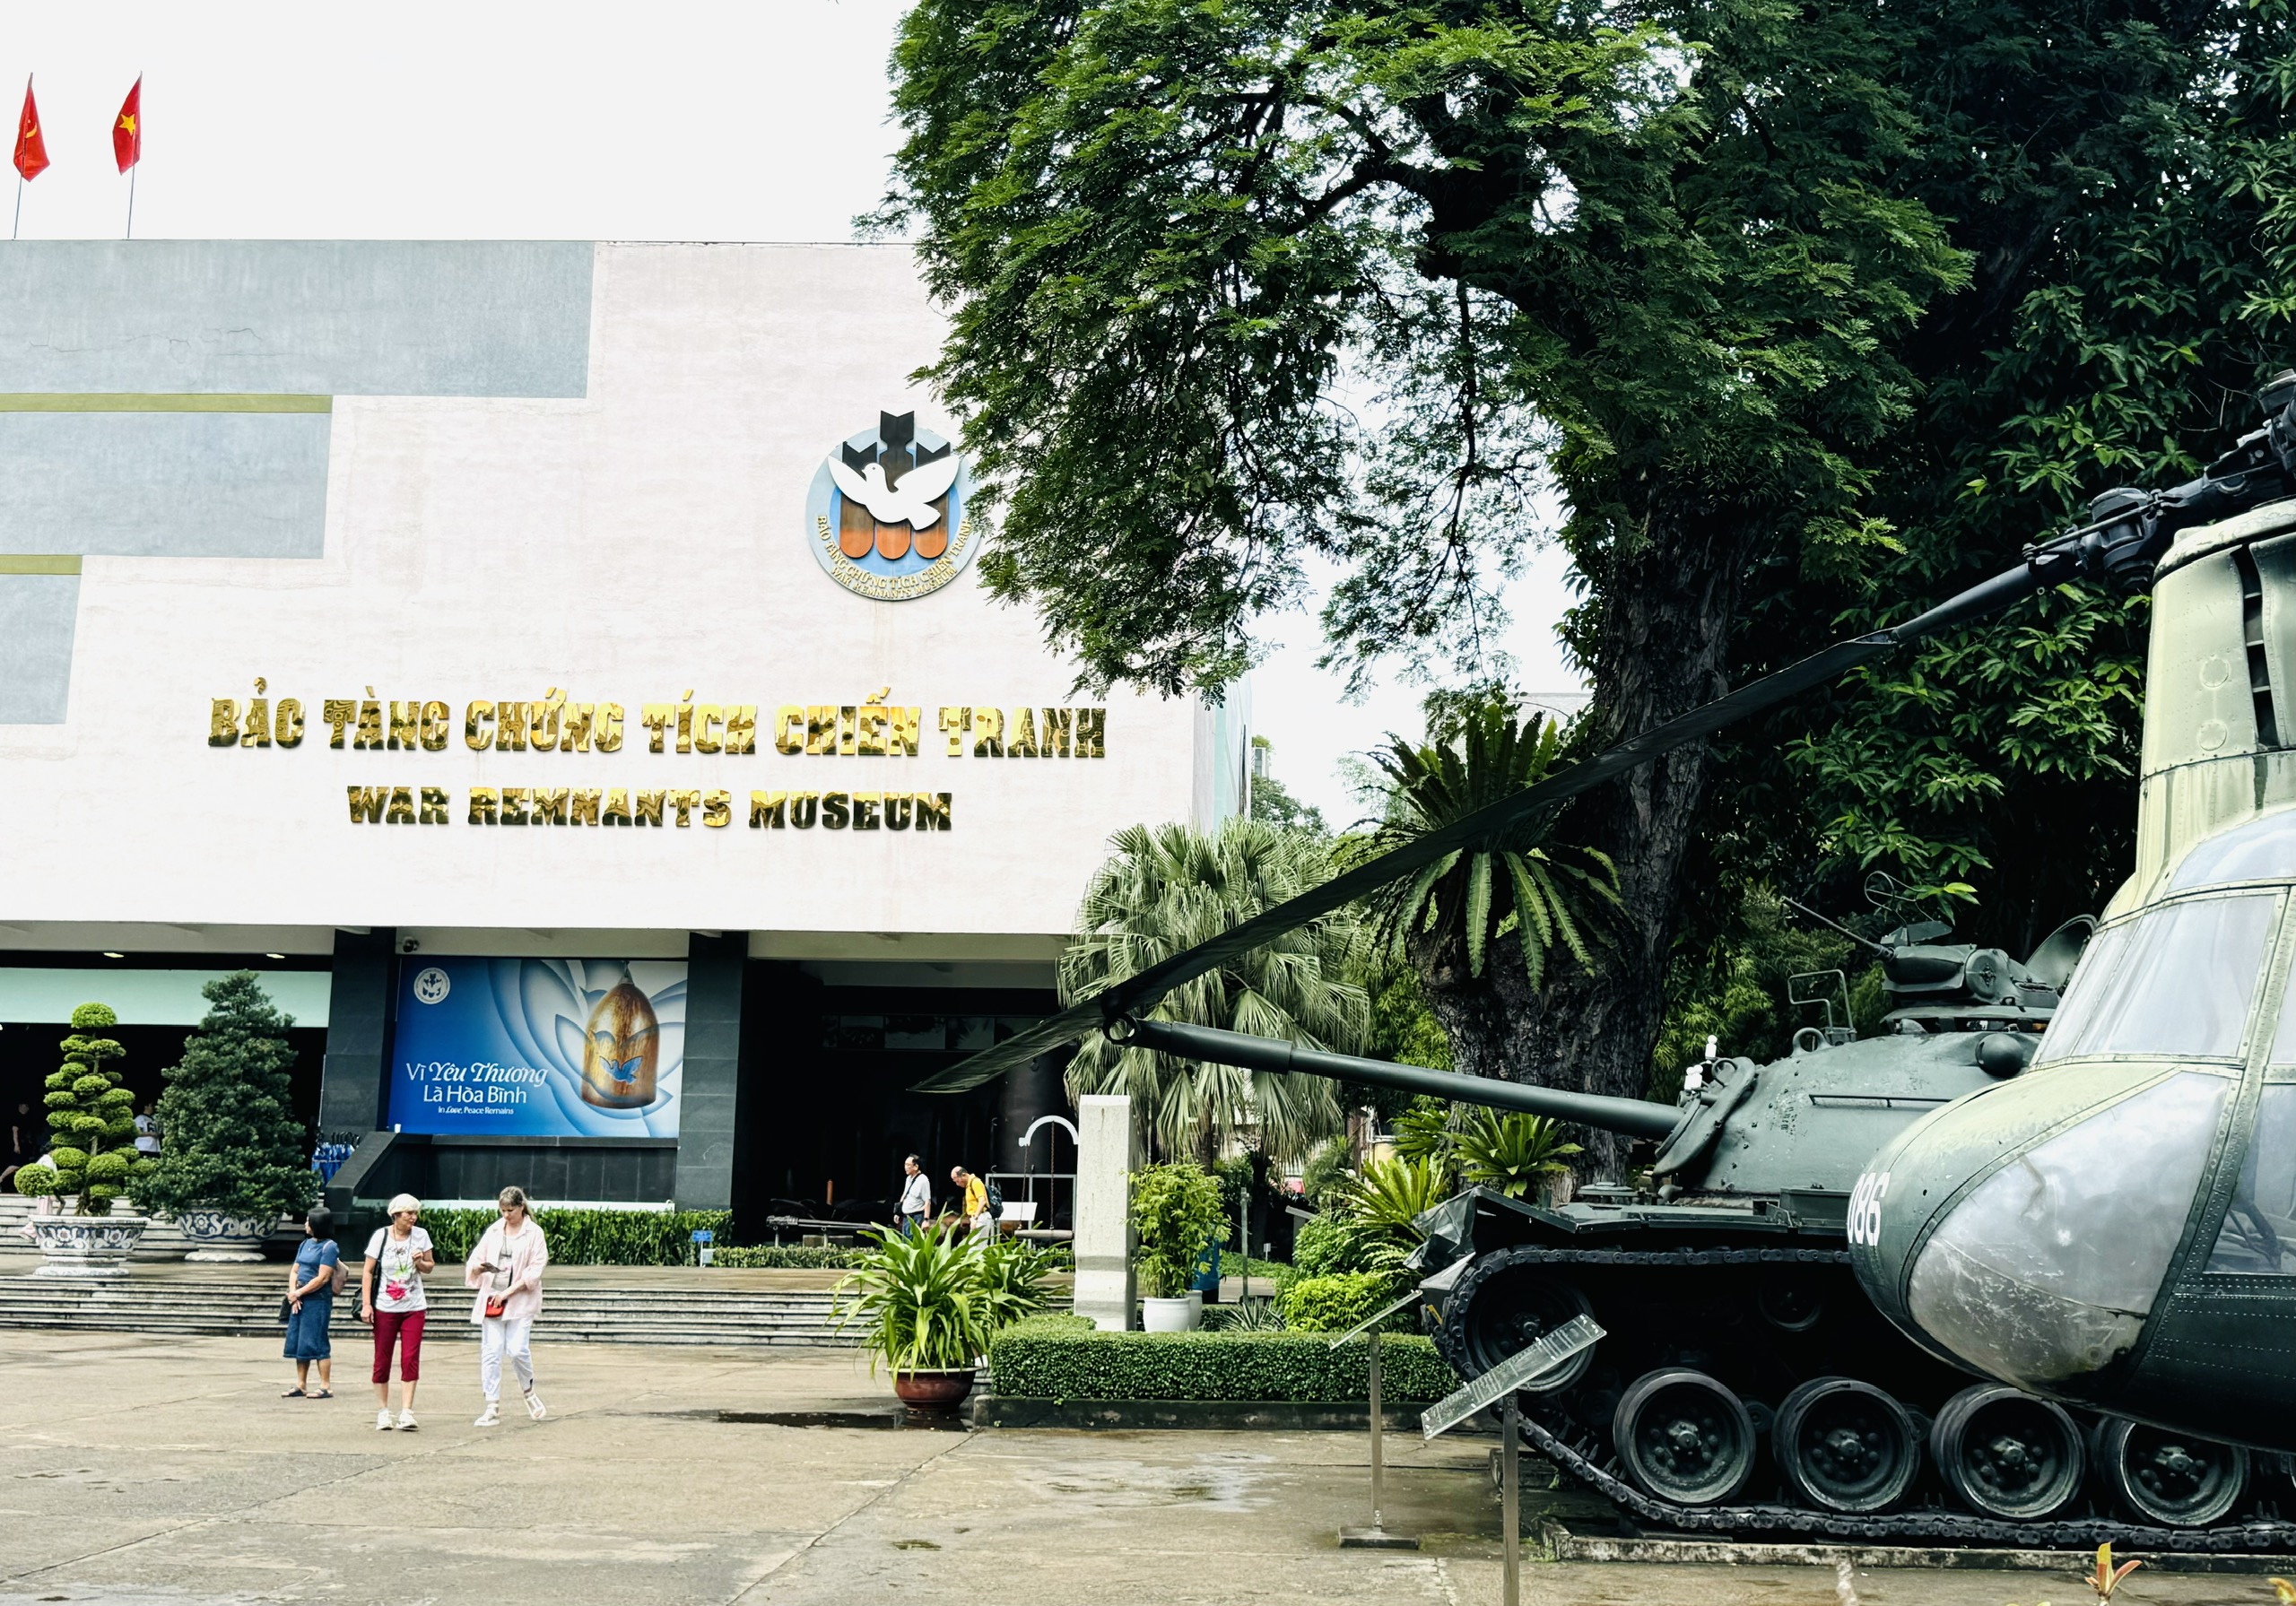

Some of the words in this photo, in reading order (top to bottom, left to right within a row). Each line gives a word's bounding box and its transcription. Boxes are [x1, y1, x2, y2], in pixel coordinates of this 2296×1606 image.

[817, 516, 831, 541] BẢO
[846, 566, 887, 588] CHỨNG
[890, 576, 919, 589] TÍCH
[948, 517, 972, 557] TRANH
[831, 567, 852, 586] WAR
[853, 582, 912, 599] REMNANTS
[915, 565, 958, 595] MUSEUM
[208, 676, 306, 749] BẢO
[323, 685, 450, 751] TÀNG
[465, 686, 624, 753] CHỨNG
[641, 689, 758, 755] TÍCH
[774, 686, 922, 757] CHIẾN
[938, 705, 1107, 759] TRANH
[346, 786, 450, 825] WAR
[468, 786, 732, 829] REMNANTS
[748, 790, 952, 831] MUSEUM
[406, 1063, 426, 1081] Vì
[429, 1062, 467, 1082] Yêu
[470, 1062, 549, 1088] Thương
[423, 1084, 443, 1102] Là
[447, 1084, 484, 1103] Hòa
[487, 1085, 527, 1104] Bình
[438, 1106, 445, 1114] In
[464, 1106, 484, 1115] Peace
[484, 1107, 515, 1116] Remains
